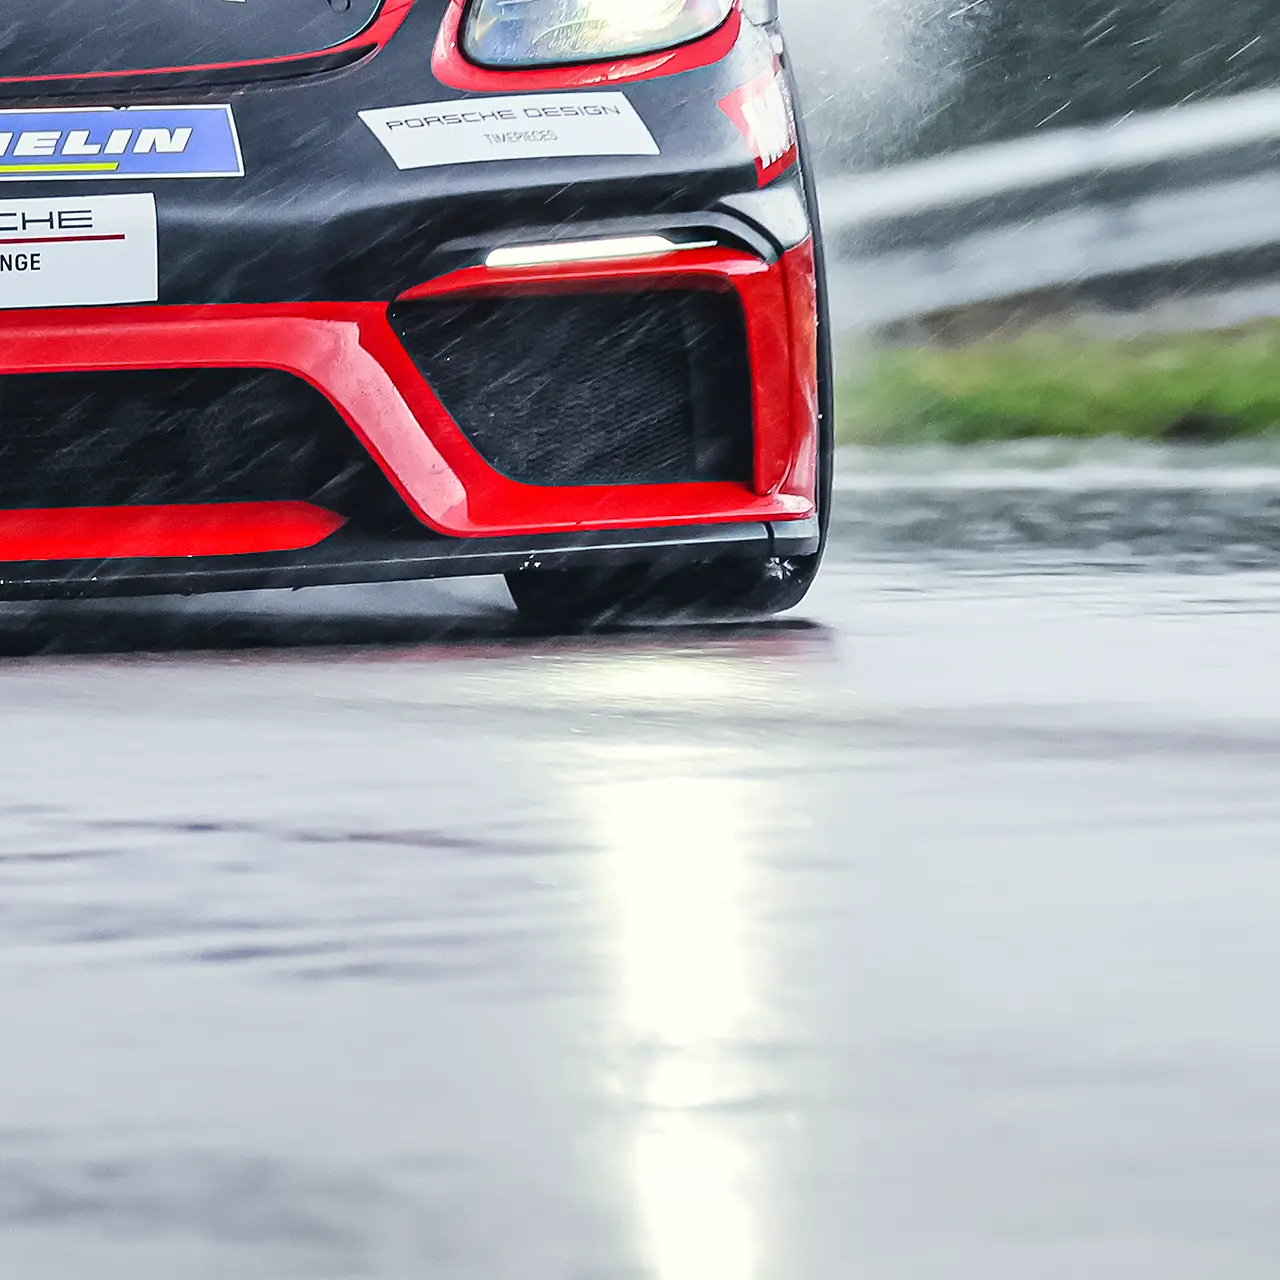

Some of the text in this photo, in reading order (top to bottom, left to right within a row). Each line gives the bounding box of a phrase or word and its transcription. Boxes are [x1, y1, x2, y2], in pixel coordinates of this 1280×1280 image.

[385, 103, 622, 131] PORSCHE DESIGN
[483, 128, 559, 145] TIMEPIECES
